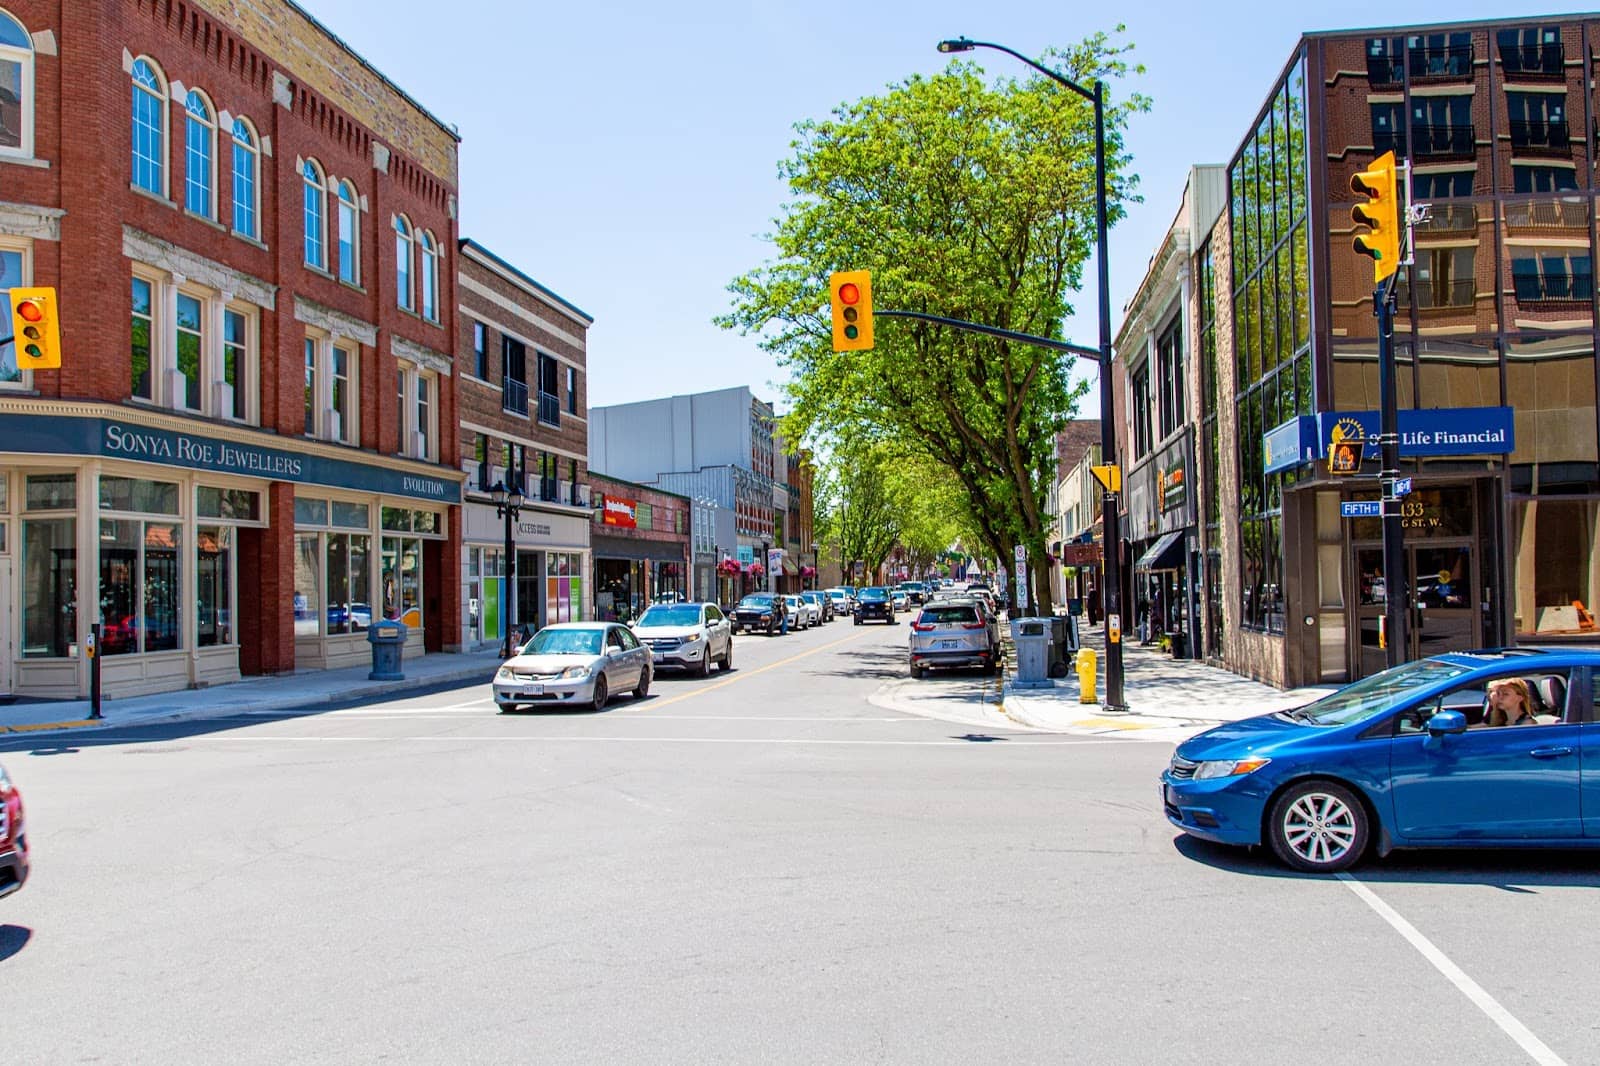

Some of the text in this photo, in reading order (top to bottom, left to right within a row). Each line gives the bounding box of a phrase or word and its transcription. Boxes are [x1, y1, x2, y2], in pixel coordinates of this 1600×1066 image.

[1402, 428, 1505, 445] Life Financial
[105, 425, 302, 476] SONYA ROE JEWELLERS
[403, 476, 444, 496] EVOLUTION
[1344, 503, 1371, 514] FIFTH
[1401, 502, 1424, 517] 133
[1412, 519, 1426, 528] ST.
[1429, 517, 1442, 527] W.
